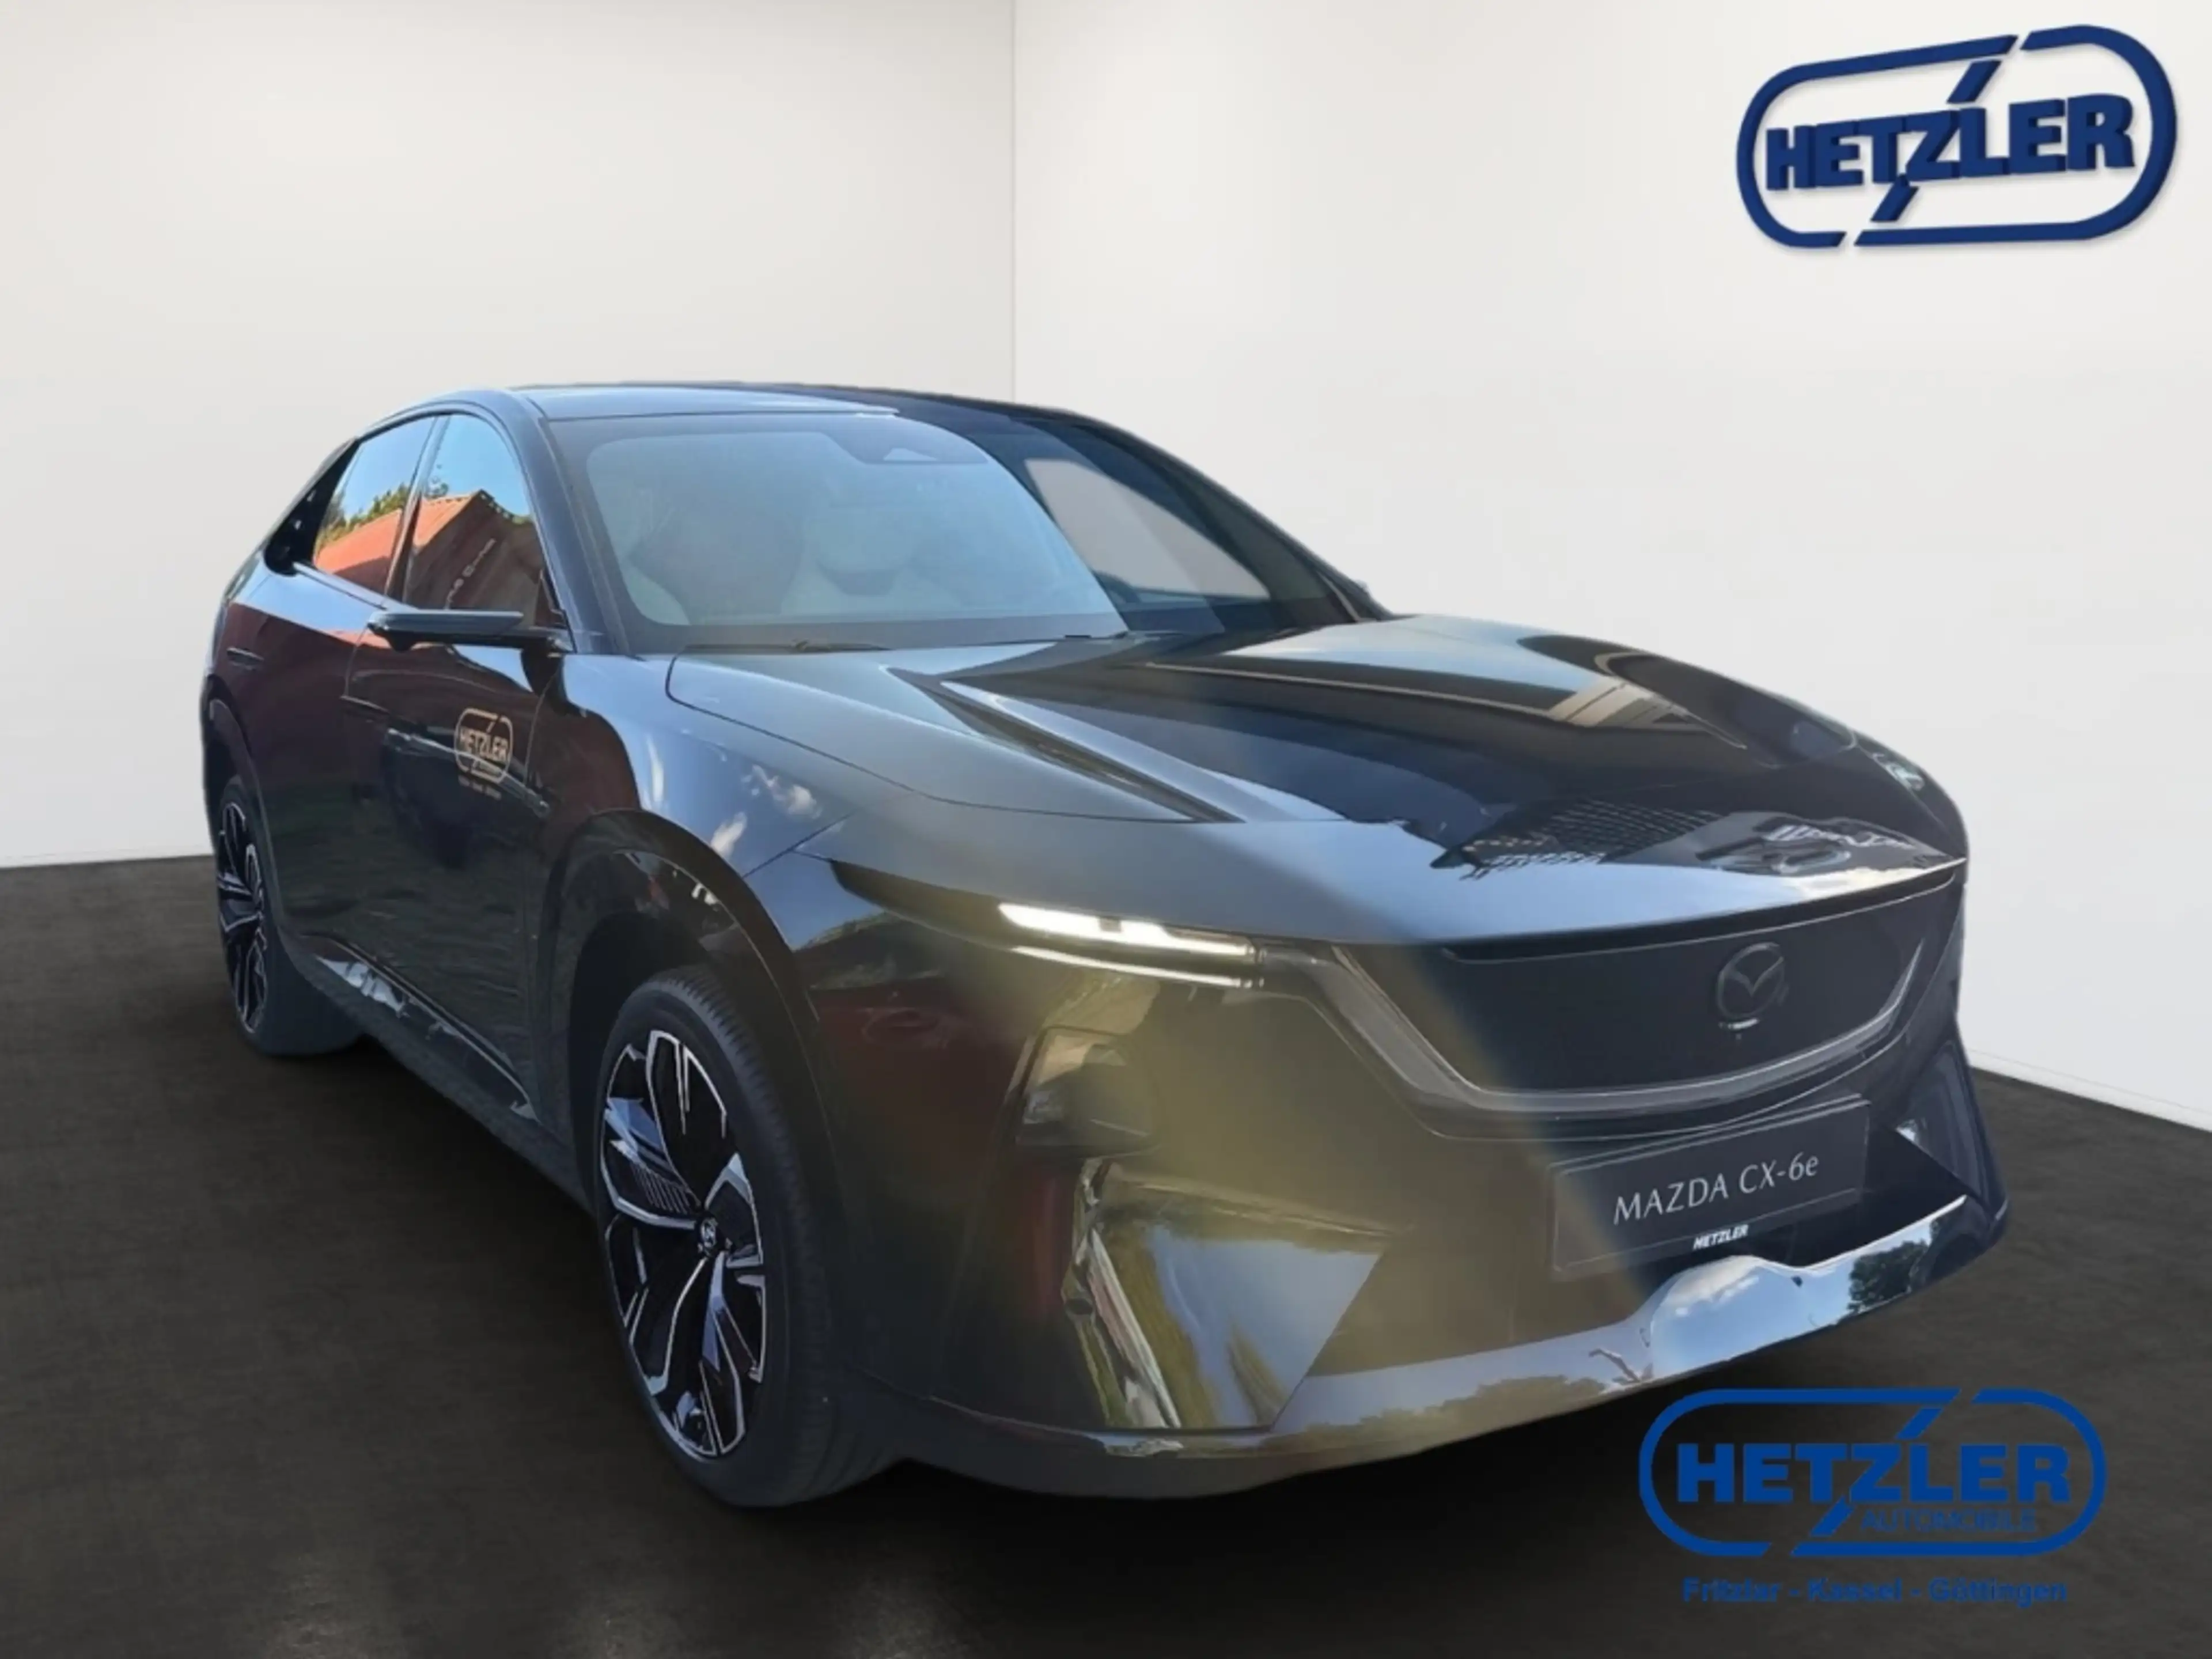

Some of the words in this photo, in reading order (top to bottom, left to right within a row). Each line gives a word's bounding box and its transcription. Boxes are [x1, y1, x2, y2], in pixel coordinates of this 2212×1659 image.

[1766, 93, 2135, 190] HETZLER
[1613, 1173, 1729, 1225] MAZDA
[1739, 1152, 1819, 1194] CX-6e
[1693, 1224, 1749, 1250] HETZLER
